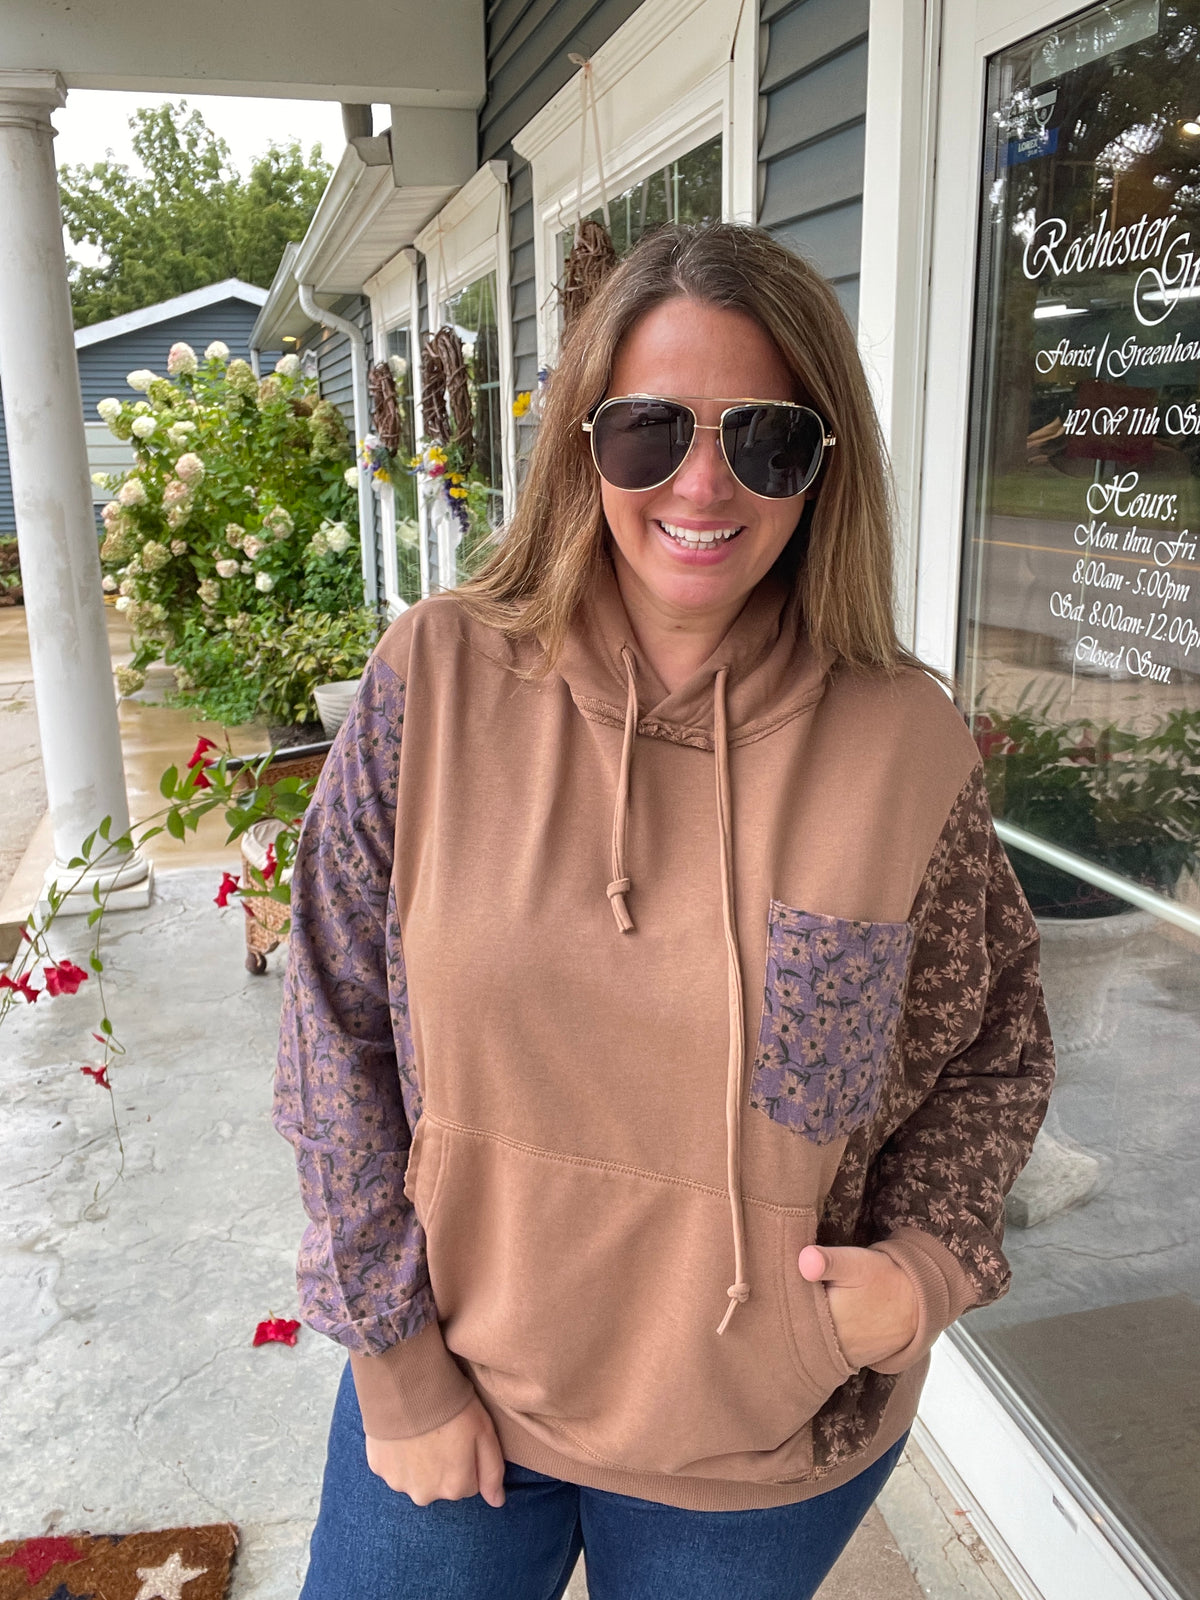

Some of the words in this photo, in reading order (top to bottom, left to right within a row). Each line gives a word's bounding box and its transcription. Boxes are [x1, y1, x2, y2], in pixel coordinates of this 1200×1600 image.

[1022, 209, 1177, 280] Rochester
[1035, 338, 1096, 374] Florist
[1063, 408, 1091, 435] 412
[1092, 406, 1129, 435] W.
[1127, 407, 1160, 435] 11th
[1086, 471, 1178, 522] Hours:
[1074, 520, 1118, 551] Mon.
[1122, 525, 1153, 554] thru
[1153, 529, 1198, 567] Fri.
[1050, 591, 1084, 622] Sat.
[1072, 558, 1124, 591] 8:00am
[1132, 568, 1191, 609] 5:00pm
[1075, 635, 1125, 669] Closed
[1126, 647, 1172, 685] Sun.
